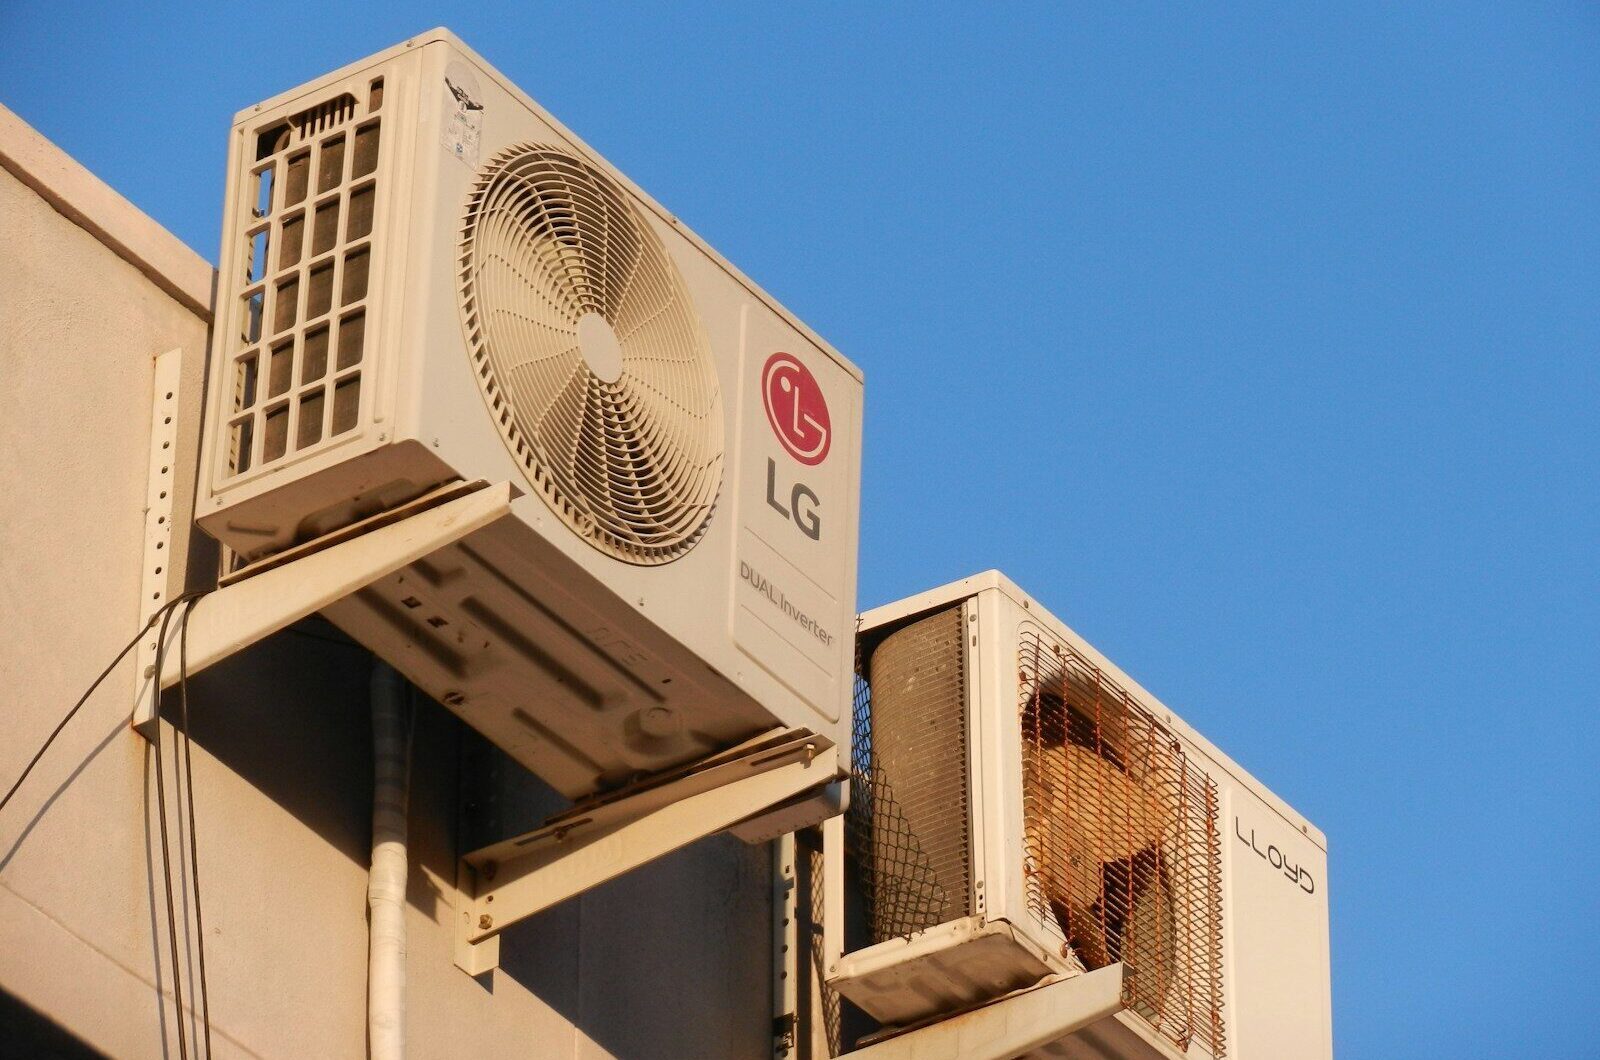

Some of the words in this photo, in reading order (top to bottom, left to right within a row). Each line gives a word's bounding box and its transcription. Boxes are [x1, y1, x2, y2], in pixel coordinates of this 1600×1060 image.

[767, 456, 820, 541] LG
[740, 560, 777, 605] DUAL
[780, 593, 833, 646] Inverter
[1235, 816, 1314, 894] LLOYD
